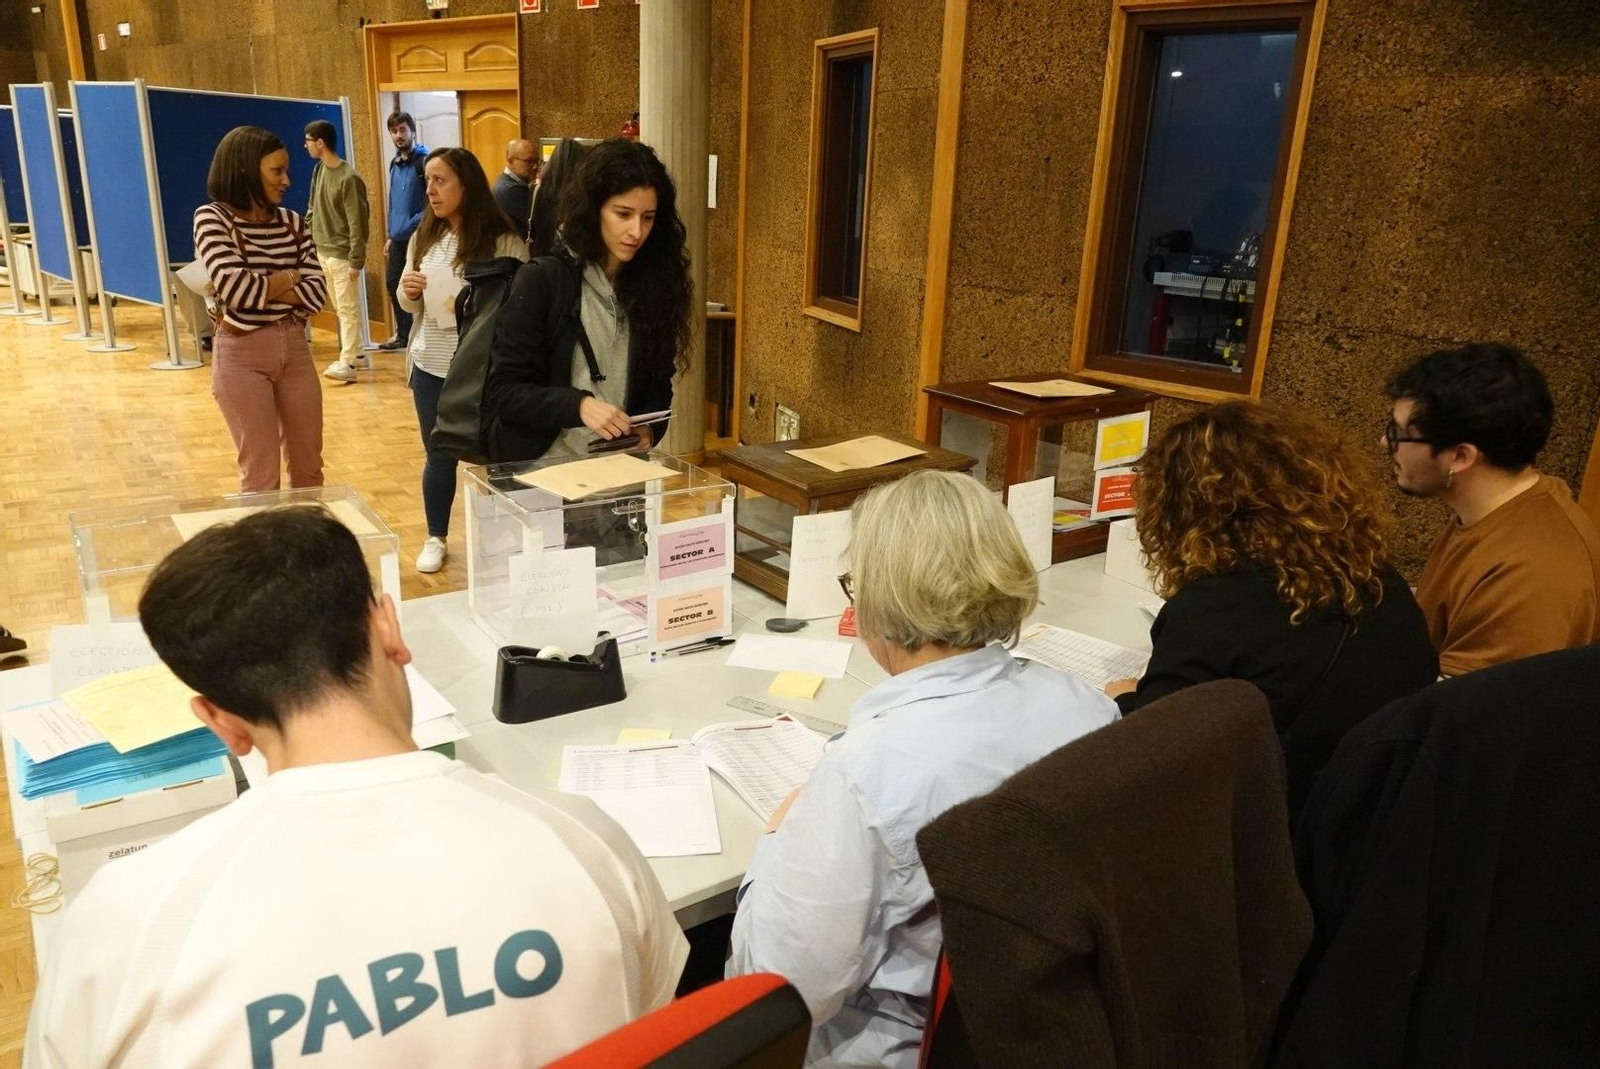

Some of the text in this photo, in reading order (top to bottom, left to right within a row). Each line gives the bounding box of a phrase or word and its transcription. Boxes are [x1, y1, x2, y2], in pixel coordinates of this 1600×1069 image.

[669, 549, 704, 562] SECTOR
[668, 612, 703, 625] SECTOR
[246, 929, 564, 1069] PABLO
